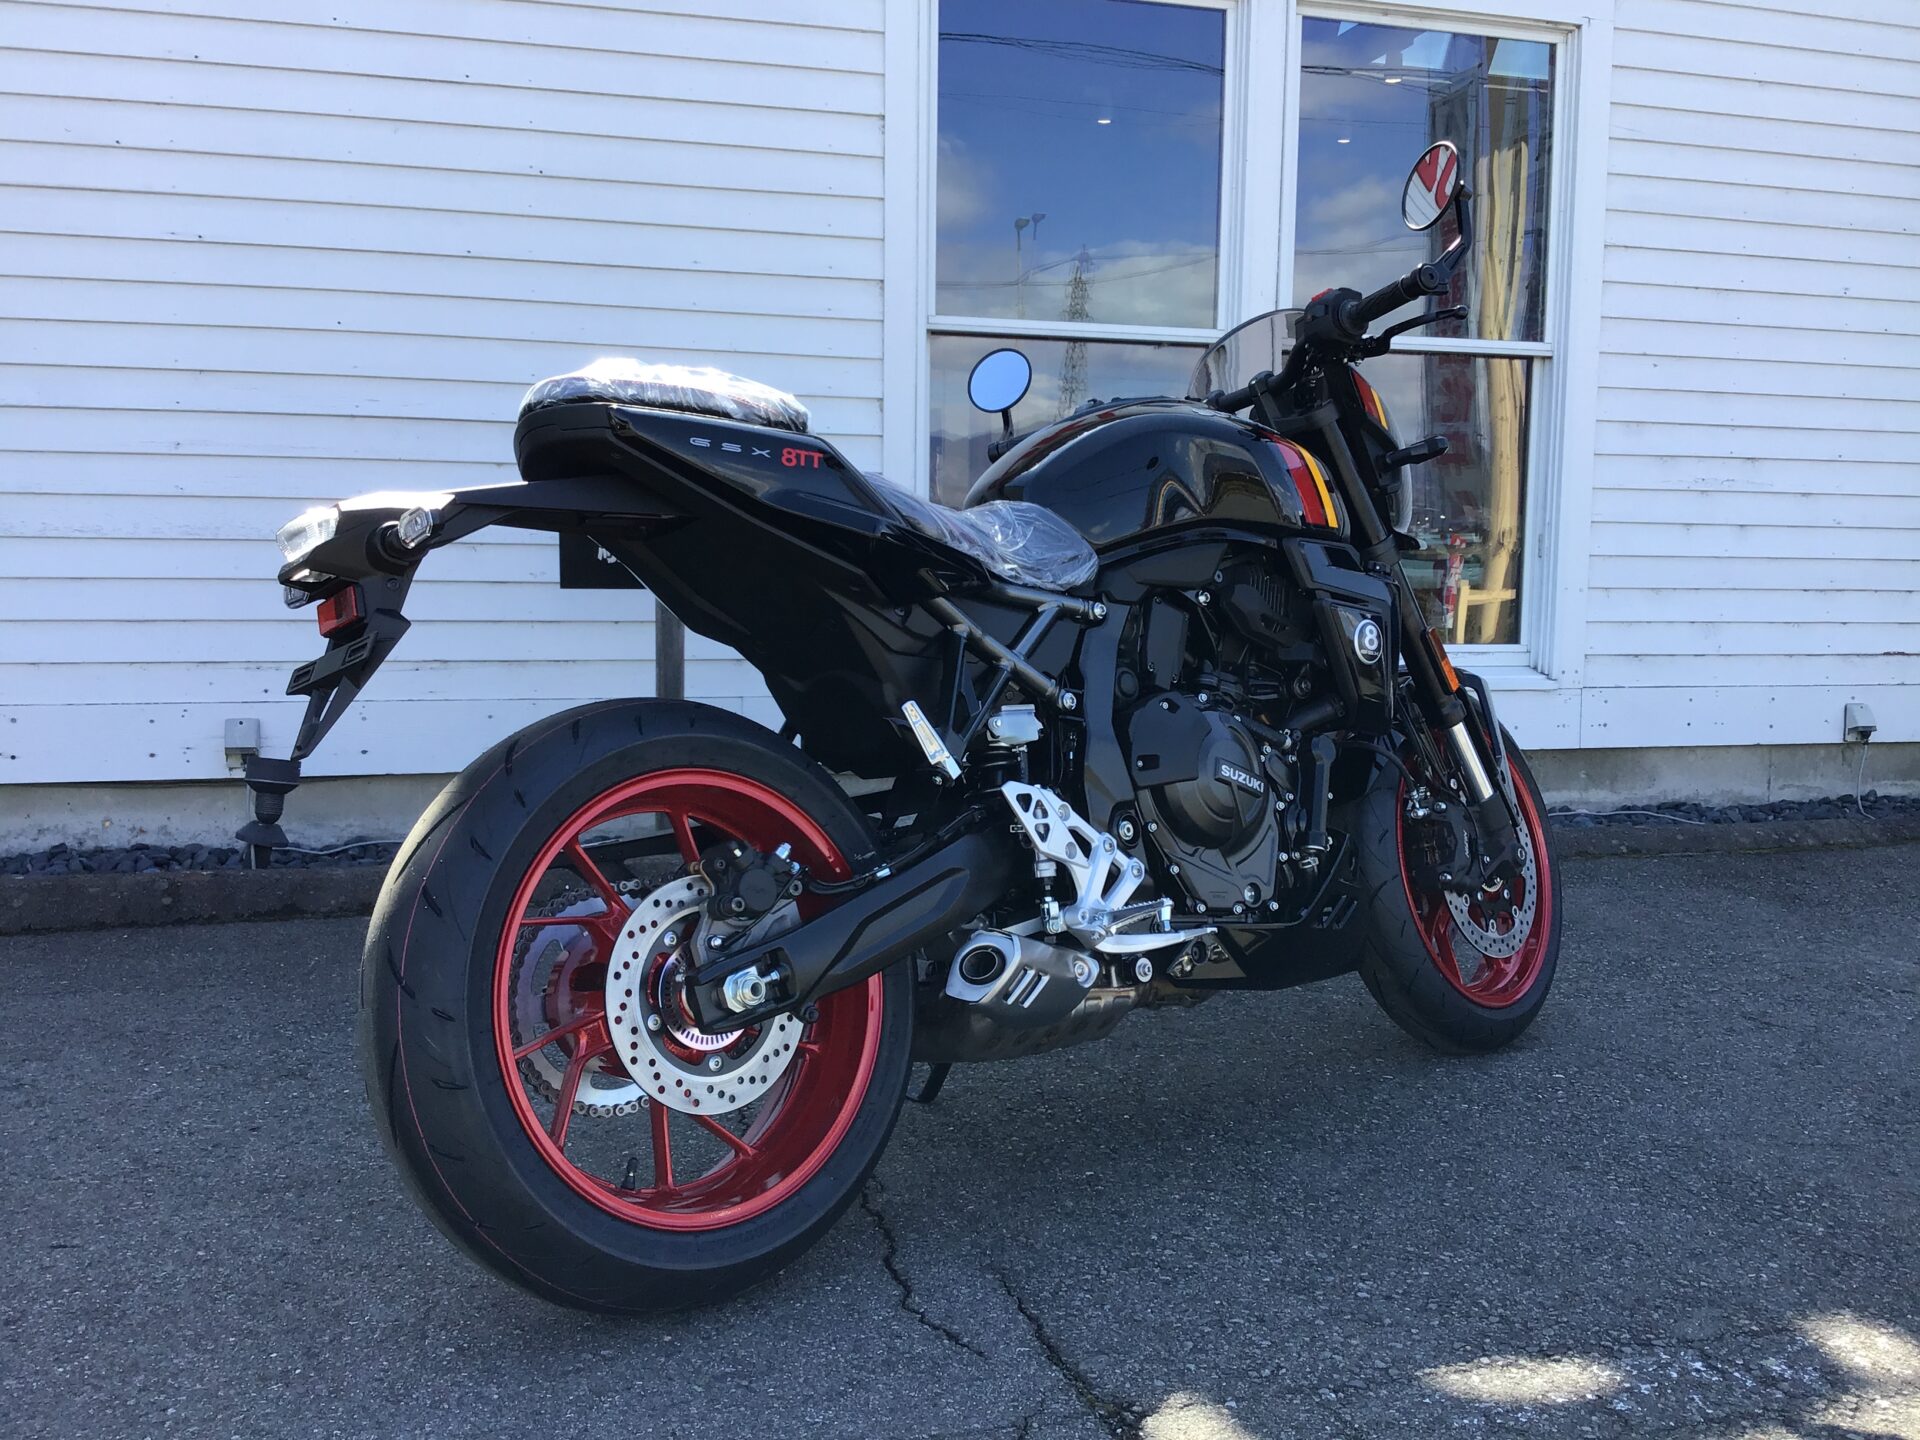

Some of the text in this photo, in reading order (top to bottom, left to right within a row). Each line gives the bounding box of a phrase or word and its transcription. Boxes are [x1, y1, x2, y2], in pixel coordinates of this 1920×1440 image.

[781, 447, 824, 469] 8TT
[1364, 625, 1379, 650] 8
[1220, 764, 1265, 793] SUZUKI
